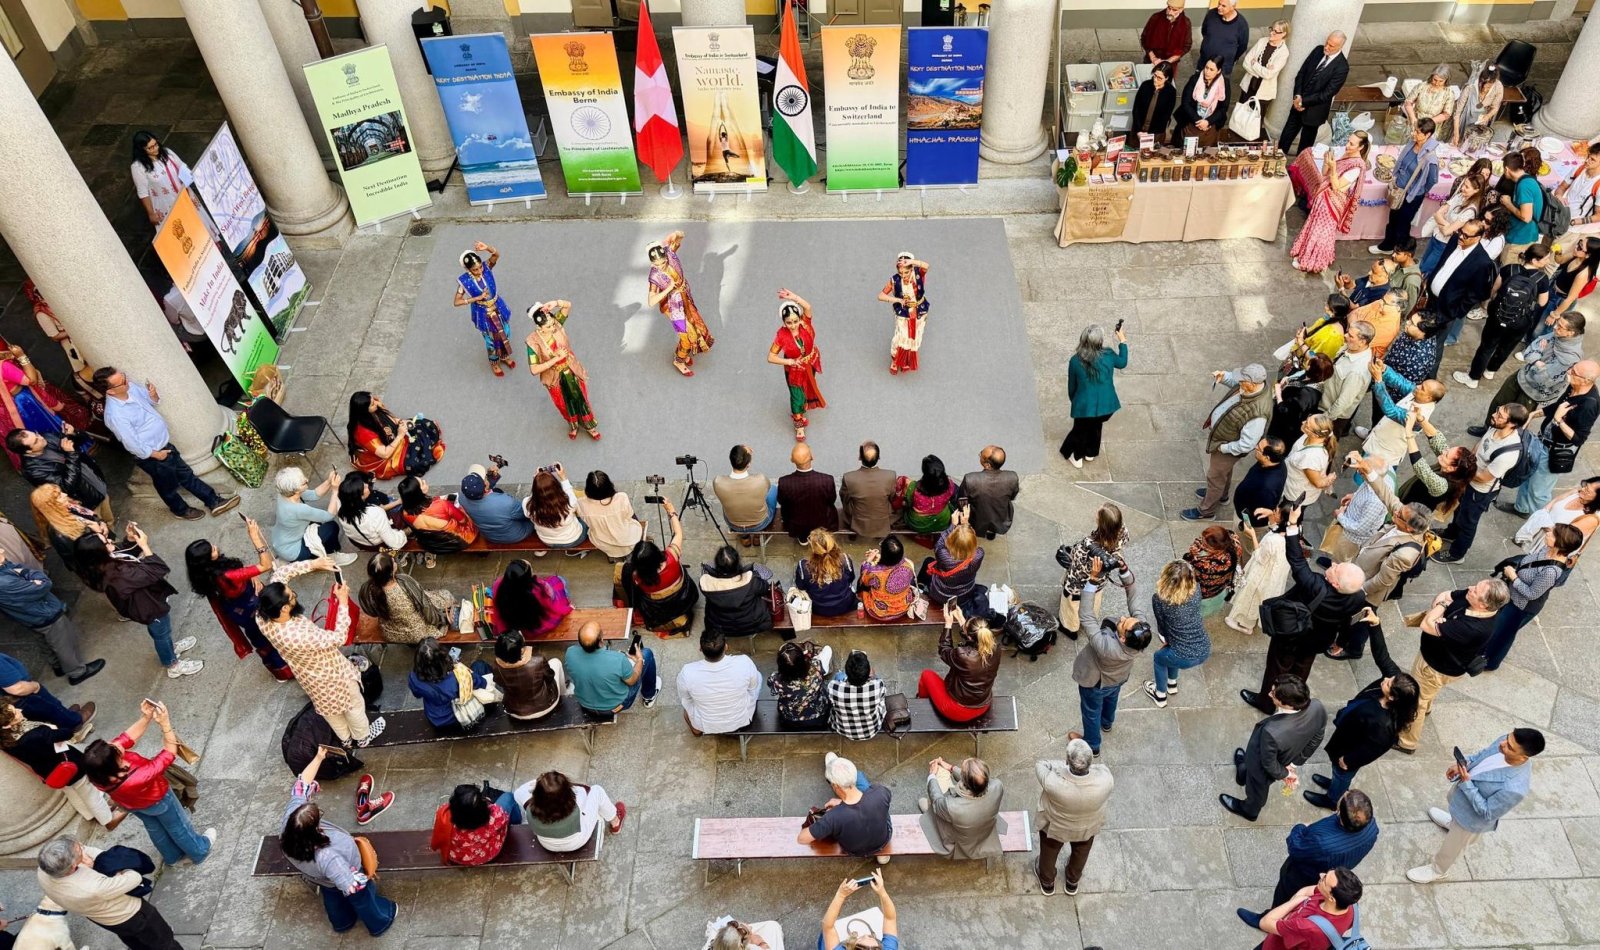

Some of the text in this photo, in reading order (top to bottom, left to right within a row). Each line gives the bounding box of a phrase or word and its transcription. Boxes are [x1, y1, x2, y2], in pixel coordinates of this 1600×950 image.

[452, 75, 492, 83] DESTINATION
[494, 71, 512, 79] INDIA
[697, 74, 744, 86] world.
[332, 98, 392, 121] Madhya Pradesh
[362, 174, 408, 191] Next Destination
[366, 181, 409, 198] Incredible India
[199, 287, 211, 308] Make
[212, 261, 226, 282] India
